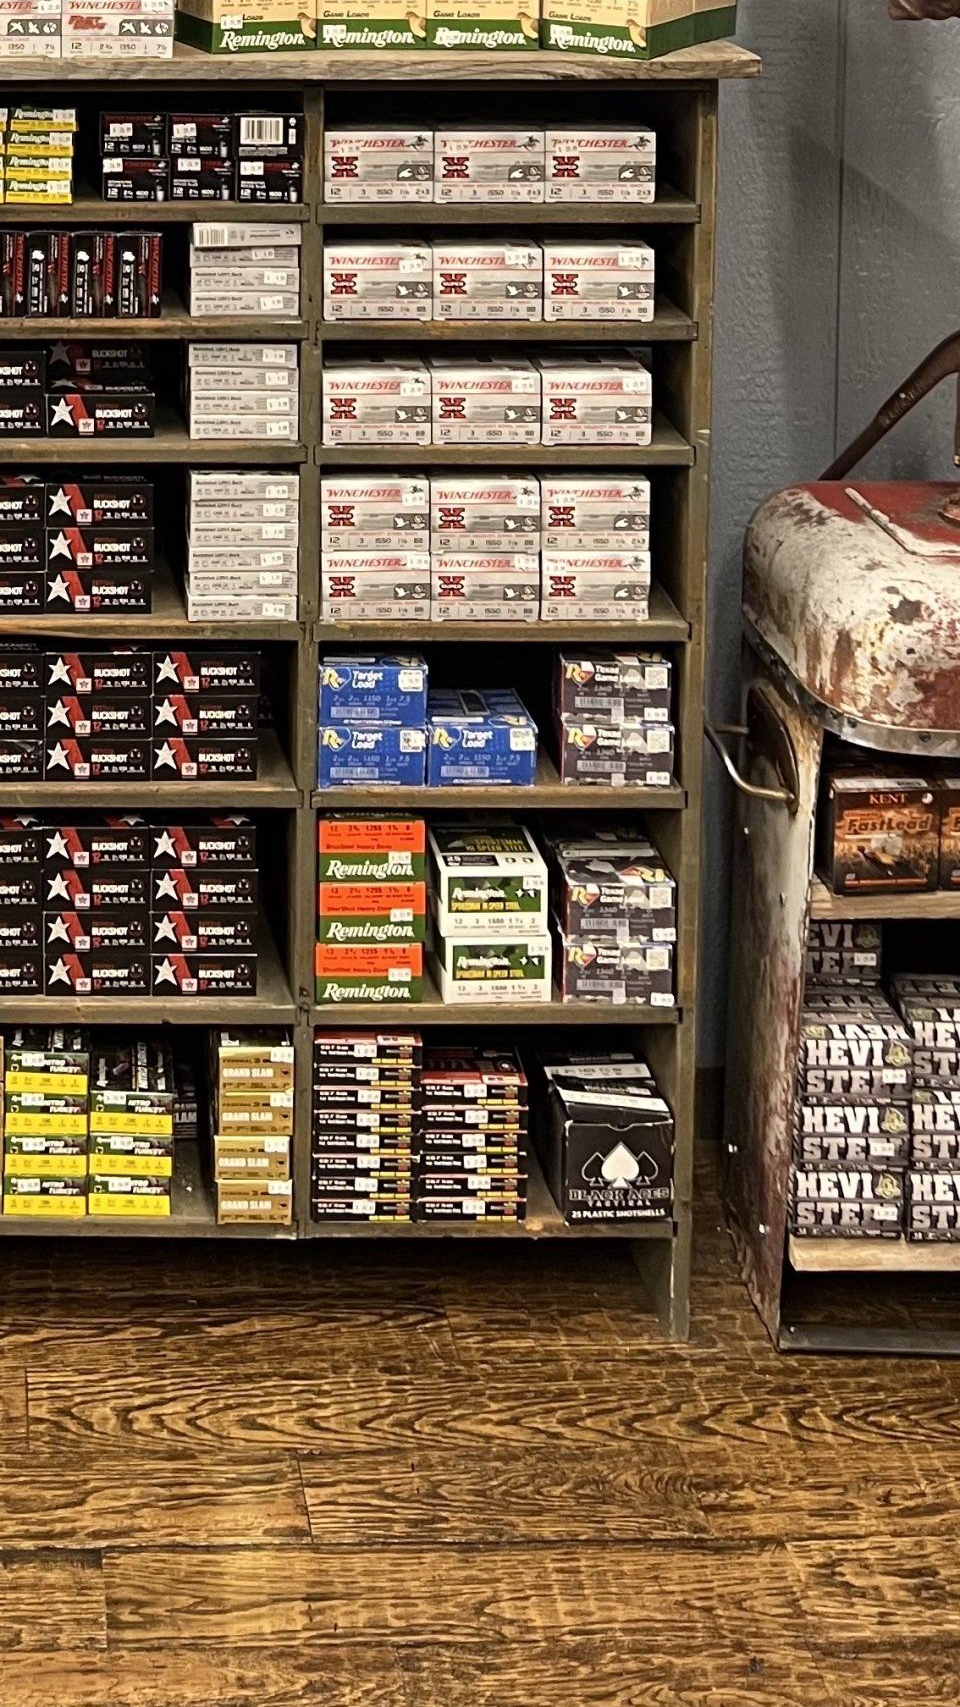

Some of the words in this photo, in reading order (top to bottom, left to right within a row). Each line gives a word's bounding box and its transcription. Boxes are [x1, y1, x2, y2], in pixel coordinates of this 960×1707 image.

[220, 31, 306, 51] Remington
[329, 381, 401, 391] WINCHESTER
[548, 381, 623, 391] WINCHESTER
[95, 409, 132, 418] BUCKSHOT
[94, 500, 130, 509] BUCKSHOT
[352, 669, 384, 682] Target
[352, 679, 376, 689] Load
[462, 729, 493, 741] Target
[462, 739, 486, 749] Load
[869, 794, 908, 805] KENT
[847, 814, 932, 832] FastLead
[326, 860, 414, 879] Remington
[326, 922, 414, 940] Remington
[323, 982, 411, 1001] Remington
[806, 1039, 884, 1066] HEVI
[251, 1068, 274, 1078] SLAM
[802, 1106, 880, 1133] HEVI
[796, 1171, 874, 1199] HEVI
[568, 1188, 627, 1201] BLACK
[628, 1188, 669, 1200] ACES
[582, 1210, 614, 1218] PLASTIC
[616, 1208, 666, 1218] SHOTSHELLS
